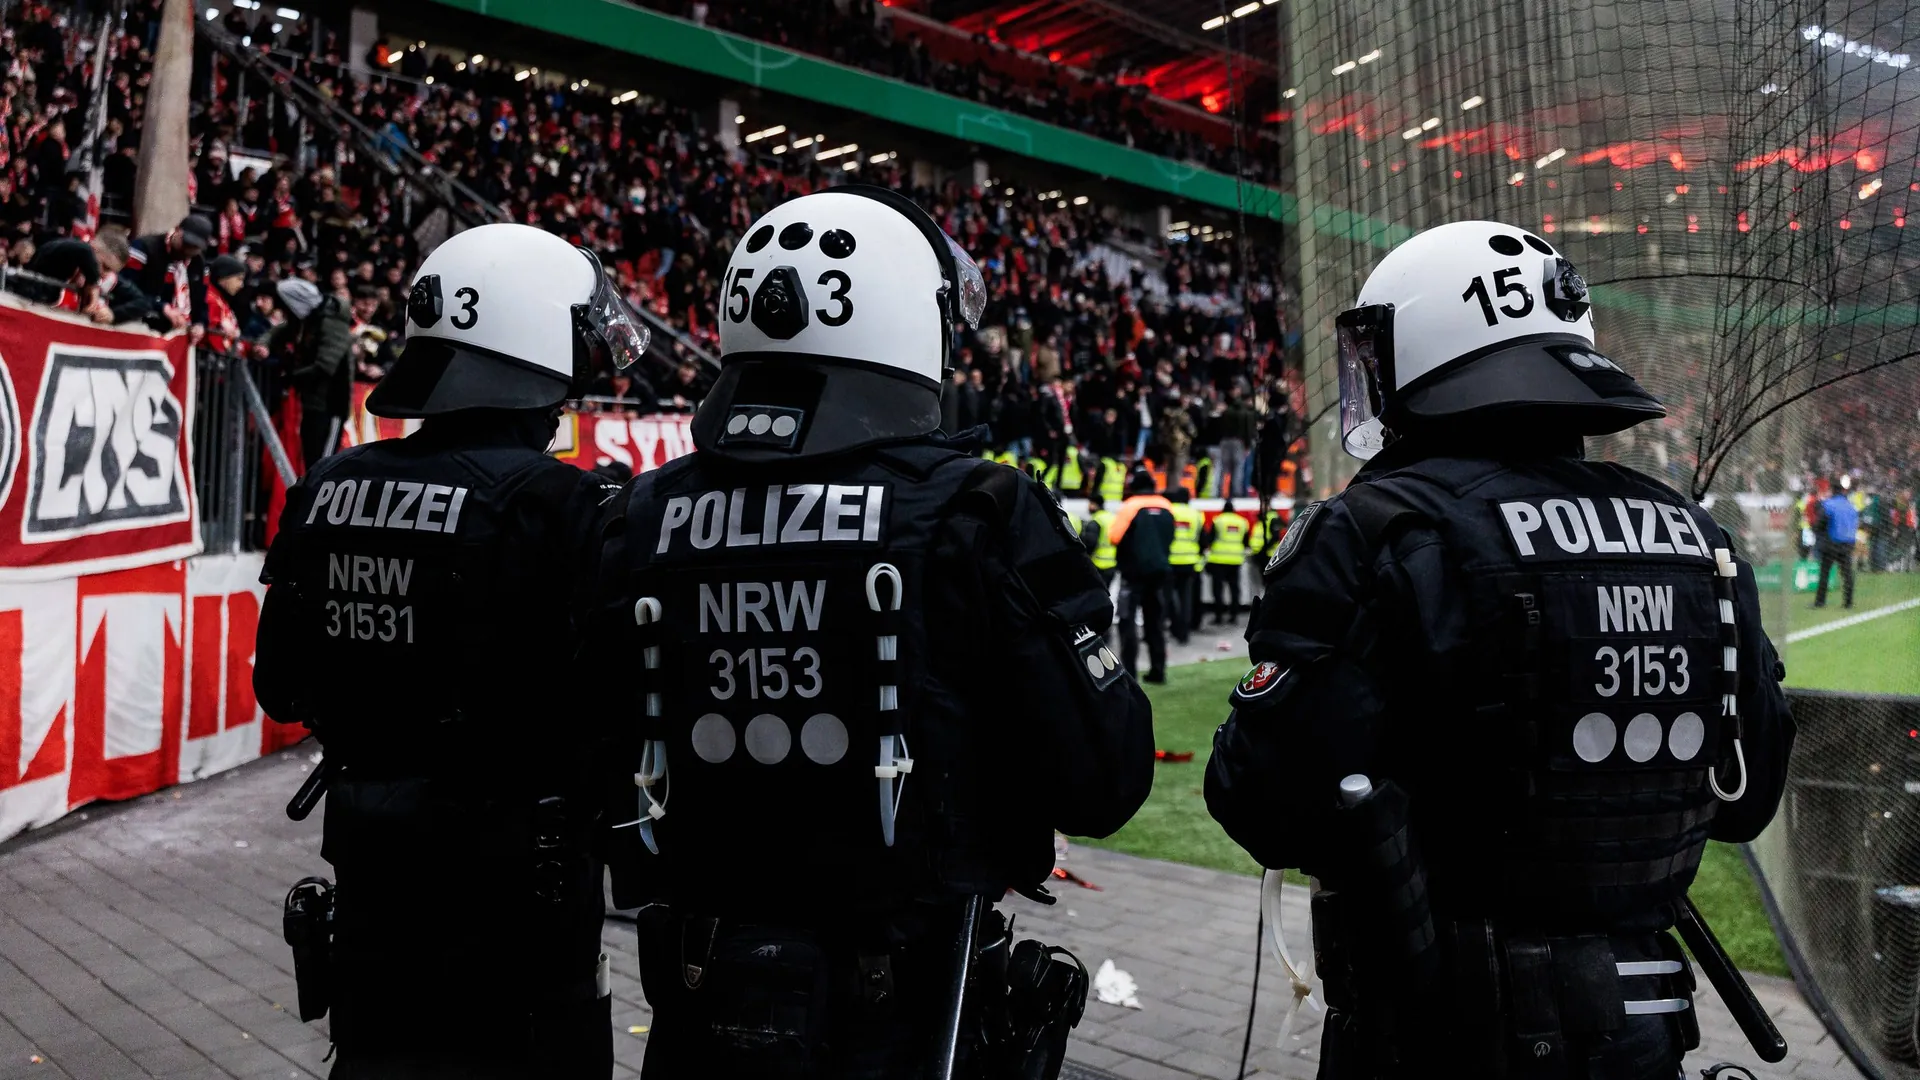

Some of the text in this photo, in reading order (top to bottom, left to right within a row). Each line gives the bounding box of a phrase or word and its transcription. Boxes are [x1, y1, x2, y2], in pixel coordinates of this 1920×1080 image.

[450, 287, 479, 330] 3
[723, 267, 854, 327] 15 3
[1462, 267, 1534, 327] 15
[305, 479, 468, 534] POLIZEI
[656, 484, 885, 554] POLIZEI
[1499, 497, 1713, 559] POLIZEI
[328, 552, 414, 596] NRW
[325, 600, 414, 644] 31531
[699, 579, 827, 633] NRW
[1596, 585, 1674, 633] NRW
[708, 646, 823, 701] 3153
[1594, 644, 1690, 698] 3153
